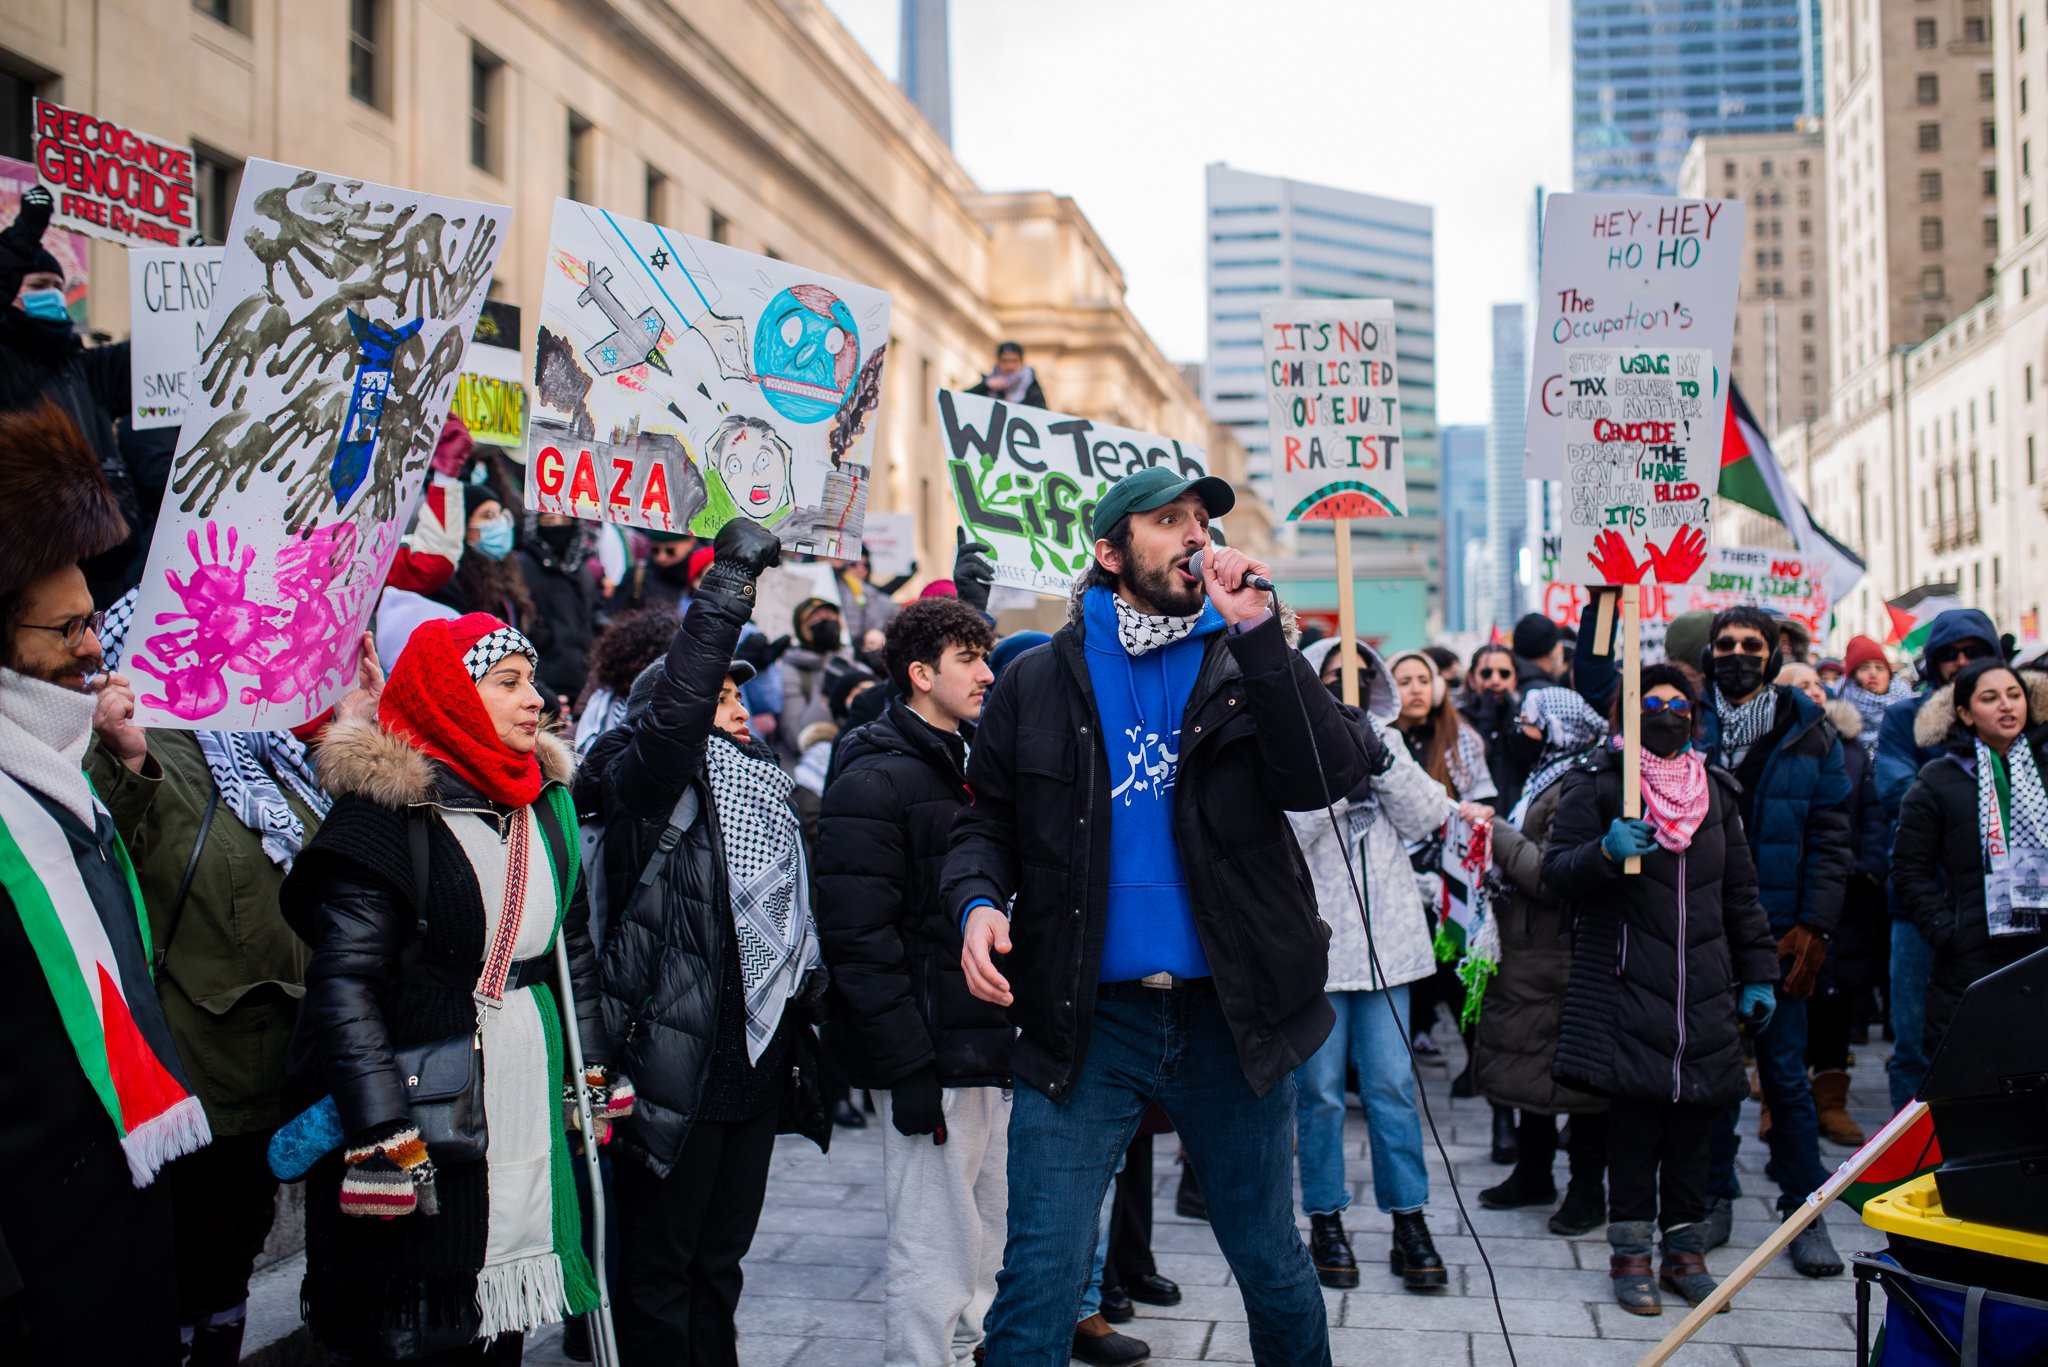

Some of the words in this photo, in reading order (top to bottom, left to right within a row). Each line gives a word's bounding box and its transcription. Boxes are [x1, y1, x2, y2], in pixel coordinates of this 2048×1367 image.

[36, 99, 193, 184] RECOGNIZE
[36, 137, 194, 228] GENOCIDE
[61, 193, 108, 228] FREE
[1593, 208, 1643, 239] HEY
[1657, 202, 1722, 240] HEY
[1608, 242, 1643, 270] HO
[1657, 236, 1701, 270] HO
[1557, 288, 1595, 314] The
[1553, 301, 1693, 344] Occupation's
[1271, 359, 1393, 388] COMPLICATED
[1569, 352, 1613, 374] STOP
[1620, 354, 1670, 375] USING
[1676, 354, 1701, 378] MY
[143, 371, 189, 400] SAVE
[1570, 377, 1608, 397] TAX
[1615, 378, 1674, 398] DOLLARS
[1676, 381, 1700, 398] TO
[1274, 392, 1346, 430] YOU'RE
[1347, 396, 1397, 427] JUST
[1568, 399, 1612, 419] FUND
[1623, 397, 1702, 420] ANOTHER
[939, 388, 1048, 473] We
[1284, 435, 1399, 473] RACIST
[1649, 445, 1687, 463] THE
[535, 446, 671, 514] GAZA
[1641, 463, 1687, 482] HAVE
[1571, 484, 1645, 507] ENOUGH
[1654, 483, 1701, 503] BLOOD
[1570, 506, 1600, 528] ON
[1771, 559, 1802, 578] NO
[1707, 571, 1752, 593] BOTH
[1759, 575, 1812, 598] SIDES
